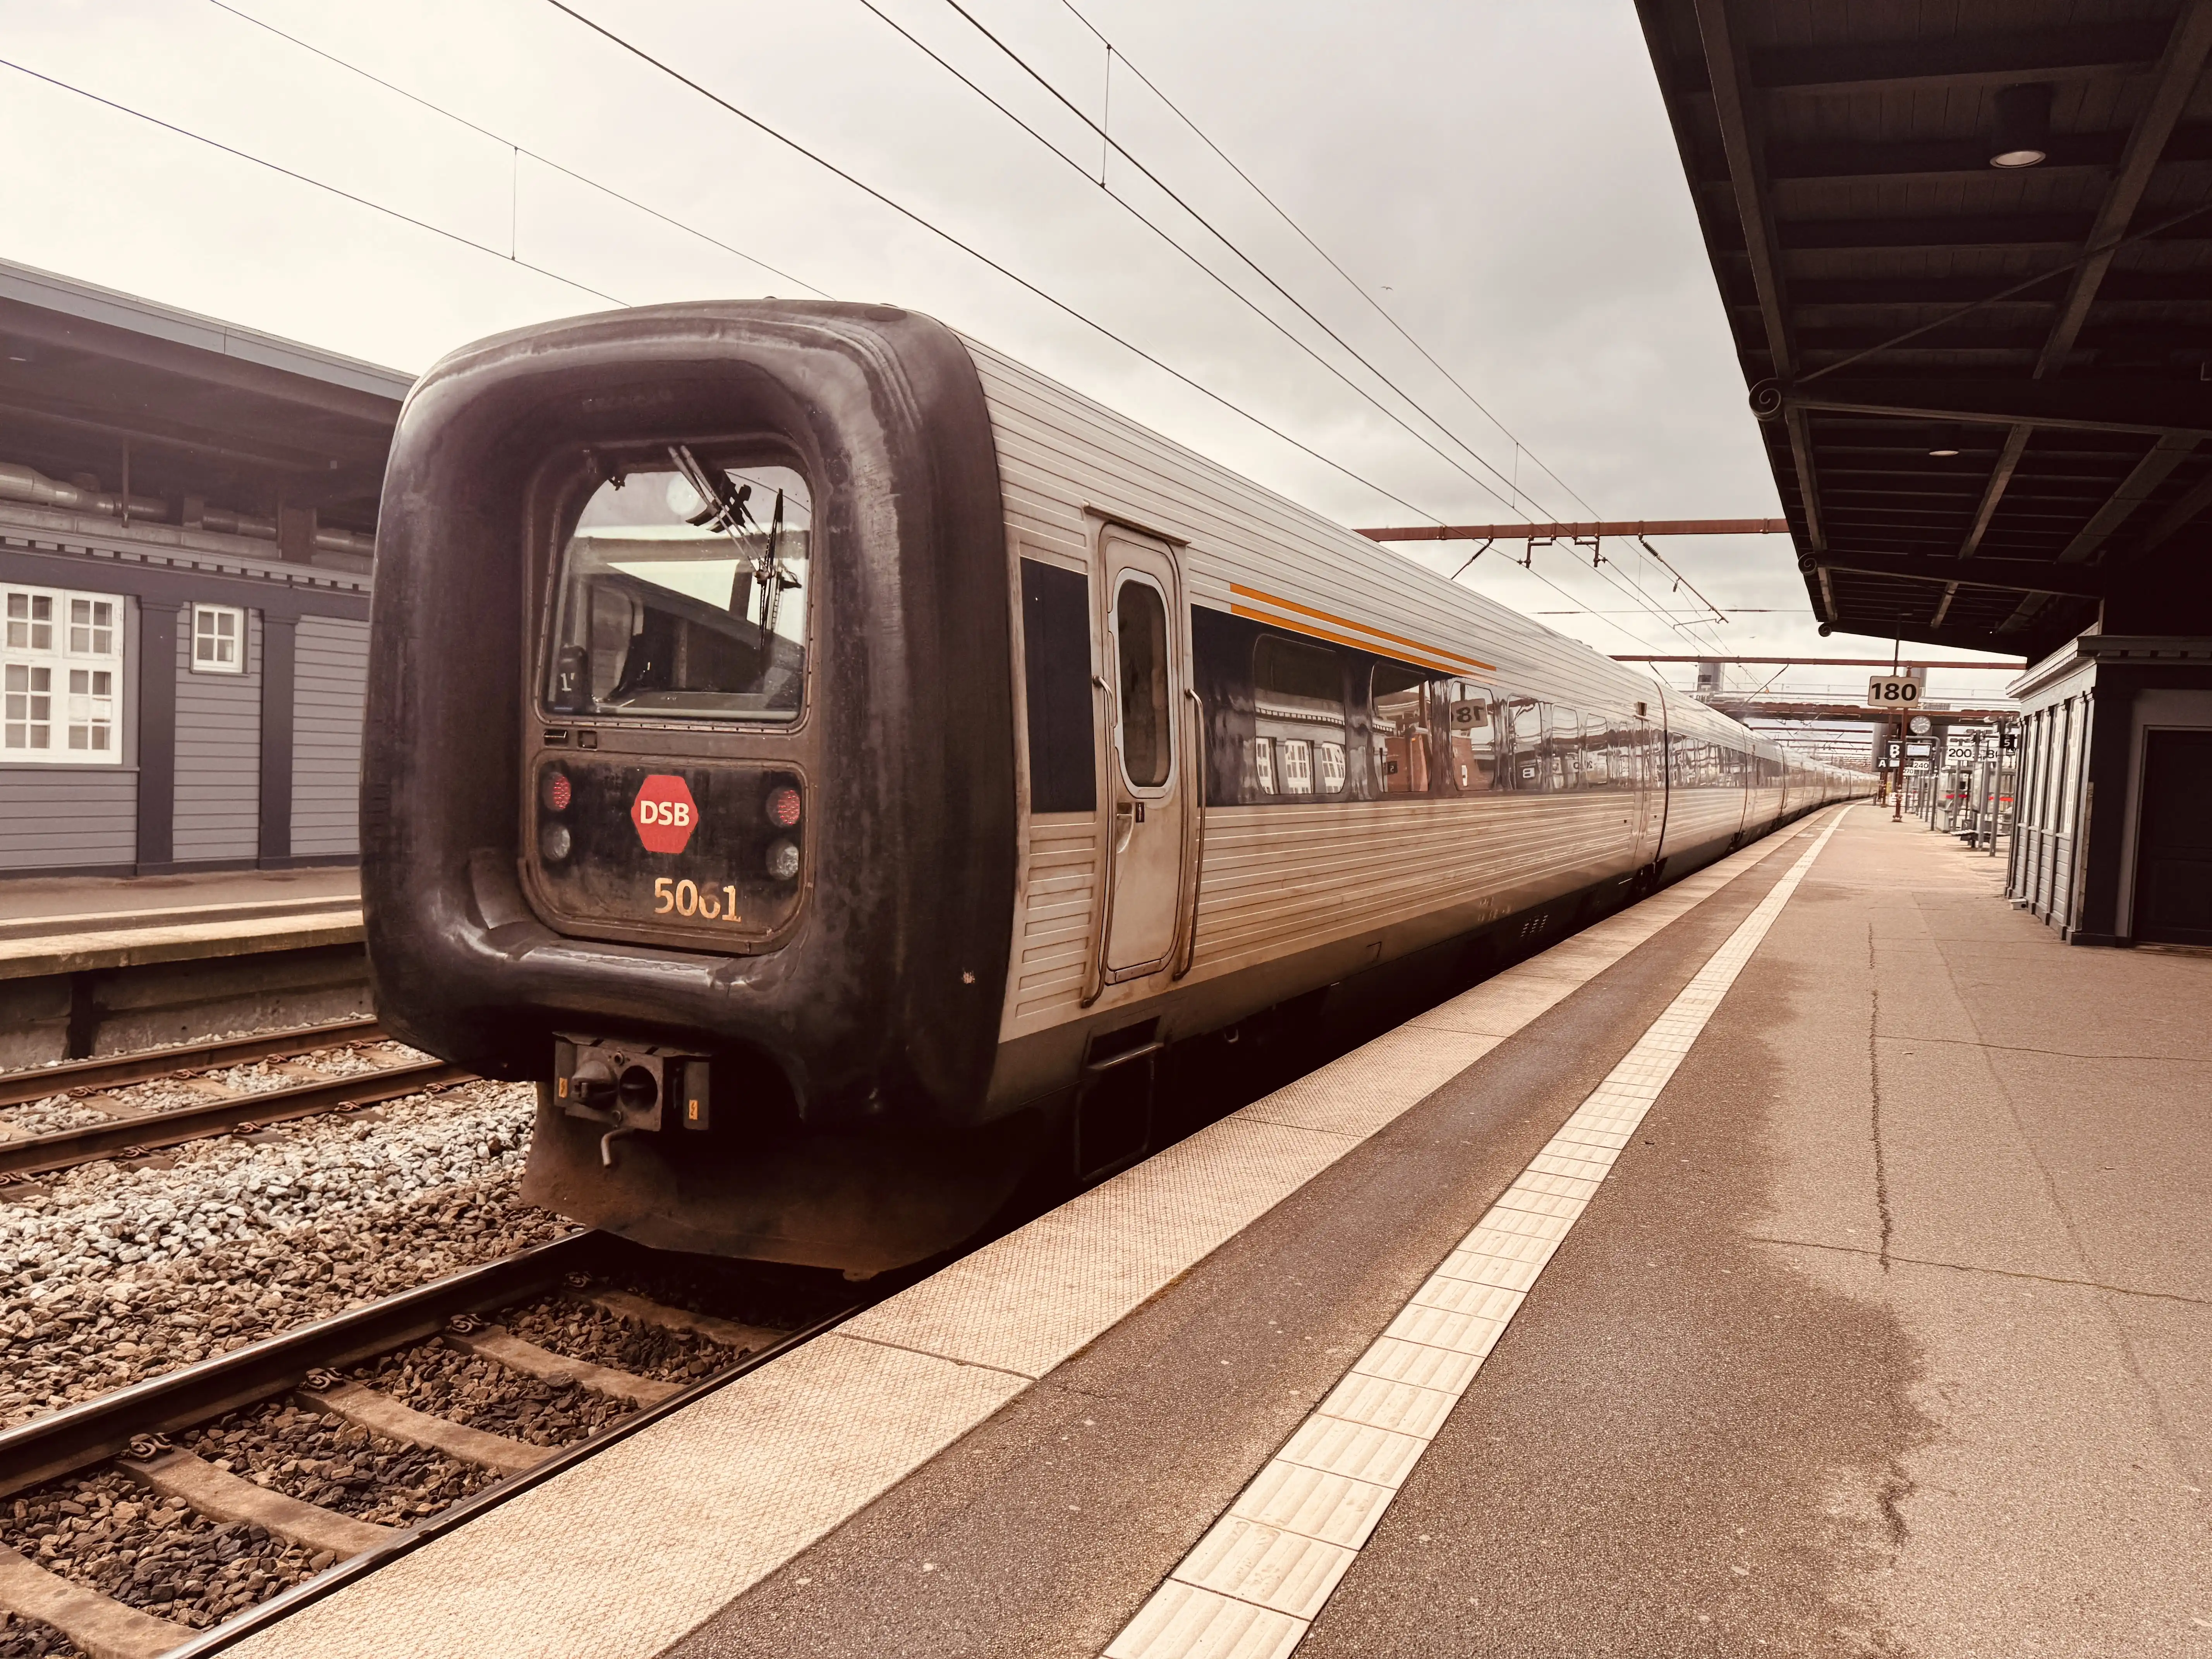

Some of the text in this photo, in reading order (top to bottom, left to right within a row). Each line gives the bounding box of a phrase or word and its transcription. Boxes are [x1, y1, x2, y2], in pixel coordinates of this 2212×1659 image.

[1872, 683, 1917, 701] 180
[1890, 744, 1900, 756] B
[1949, 749, 1972, 757] 200
[640, 800, 690, 826] DSB
[654, 878, 741, 922] 5061
